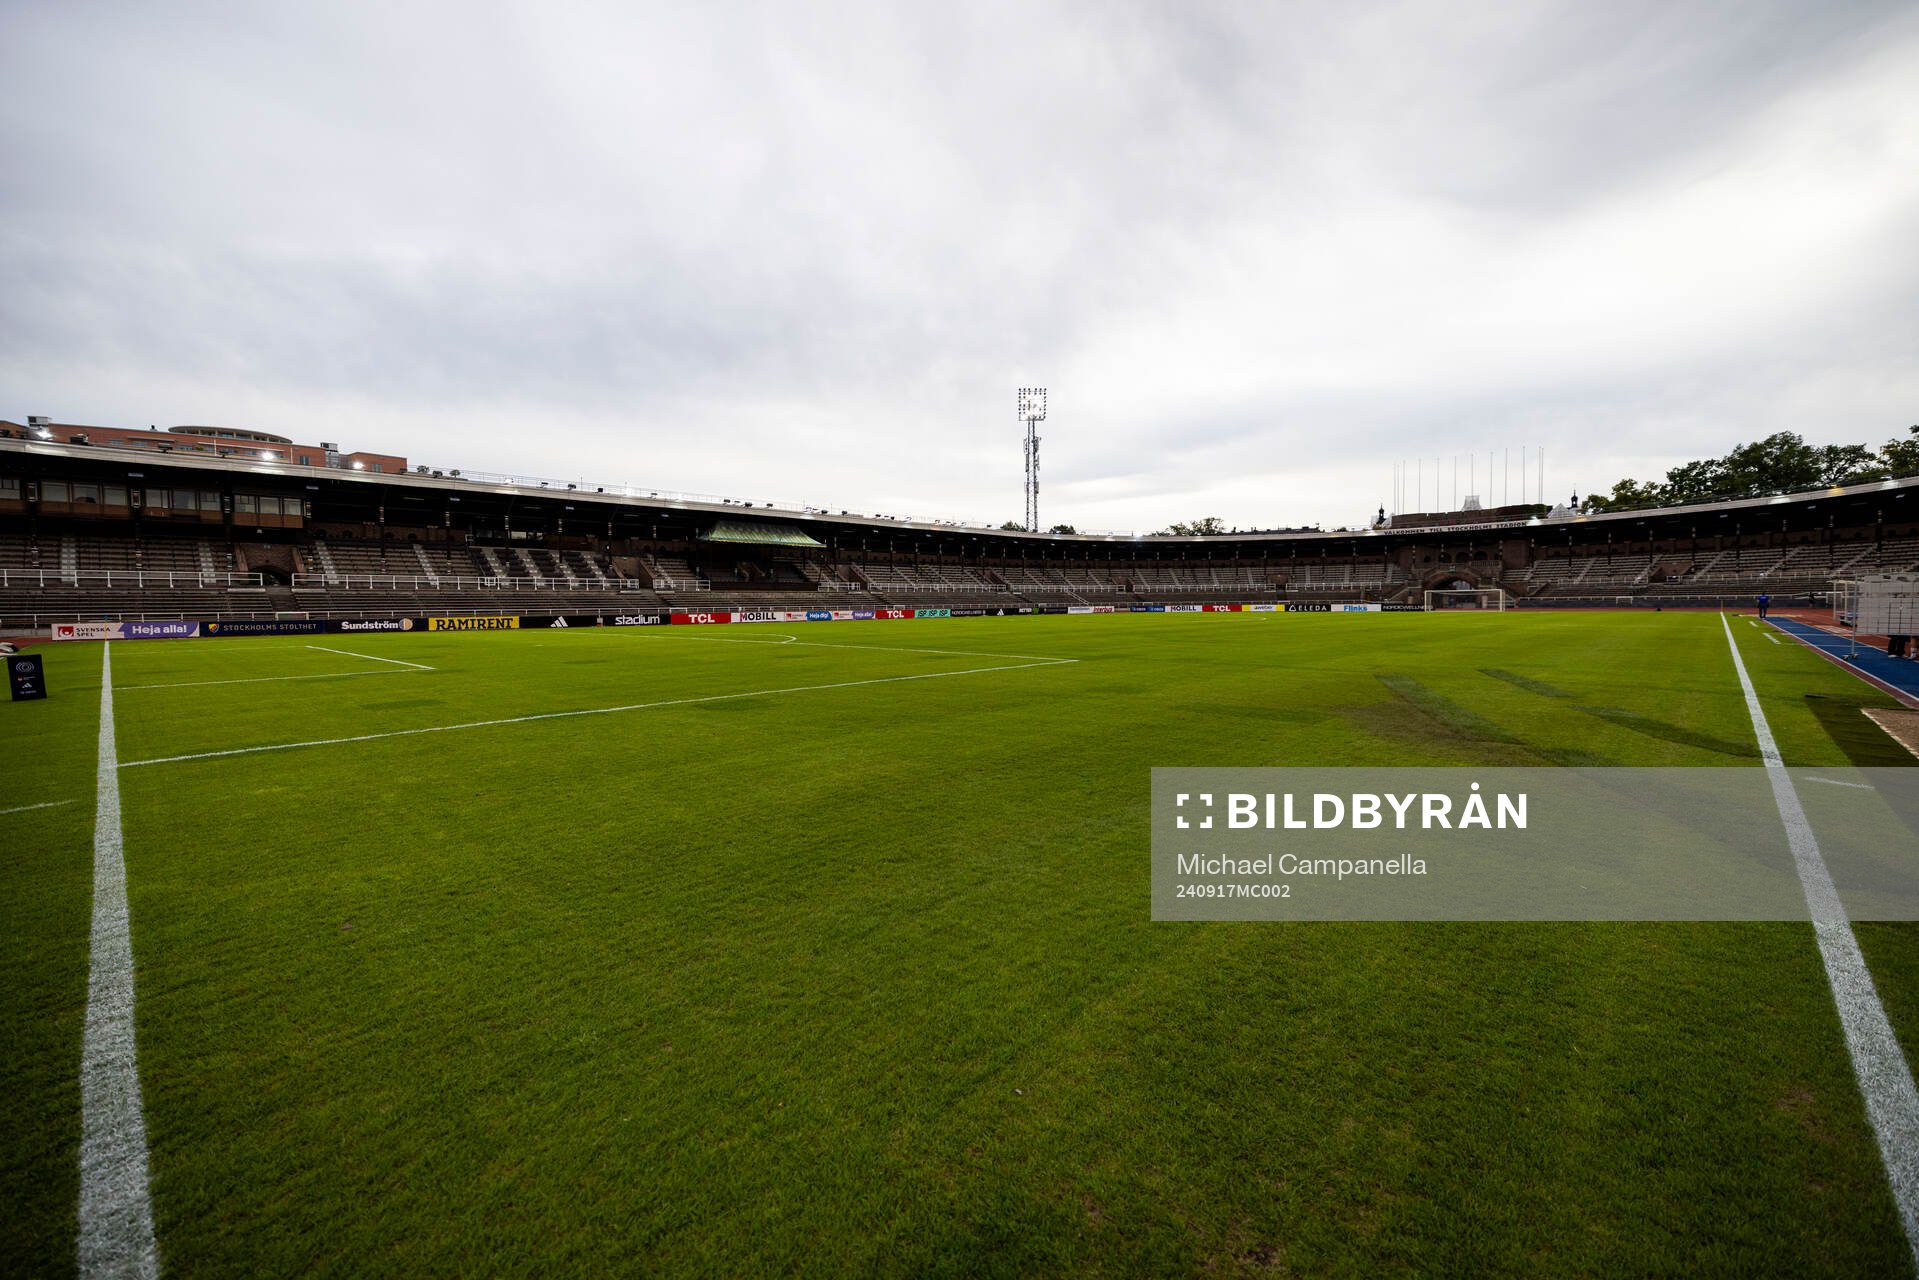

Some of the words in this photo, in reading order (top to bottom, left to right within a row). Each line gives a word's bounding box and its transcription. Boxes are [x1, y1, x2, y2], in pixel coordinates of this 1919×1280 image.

[615, 614, 660, 625] stadium
[688, 613, 715, 624] TCL
[739, 612, 777, 621] MOBILL
[887, 610, 904, 618] TCL
[223, 624, 277, 632] STOCKHOLMS
[279, 623, 317, 631] STOLTHET
[341, 619, 399, 630] Sundström
[435, 617, 514, 630] RAMIRENT
[132, 625, 161, 635] Heja
[162, 624, 187, 634] alla!
